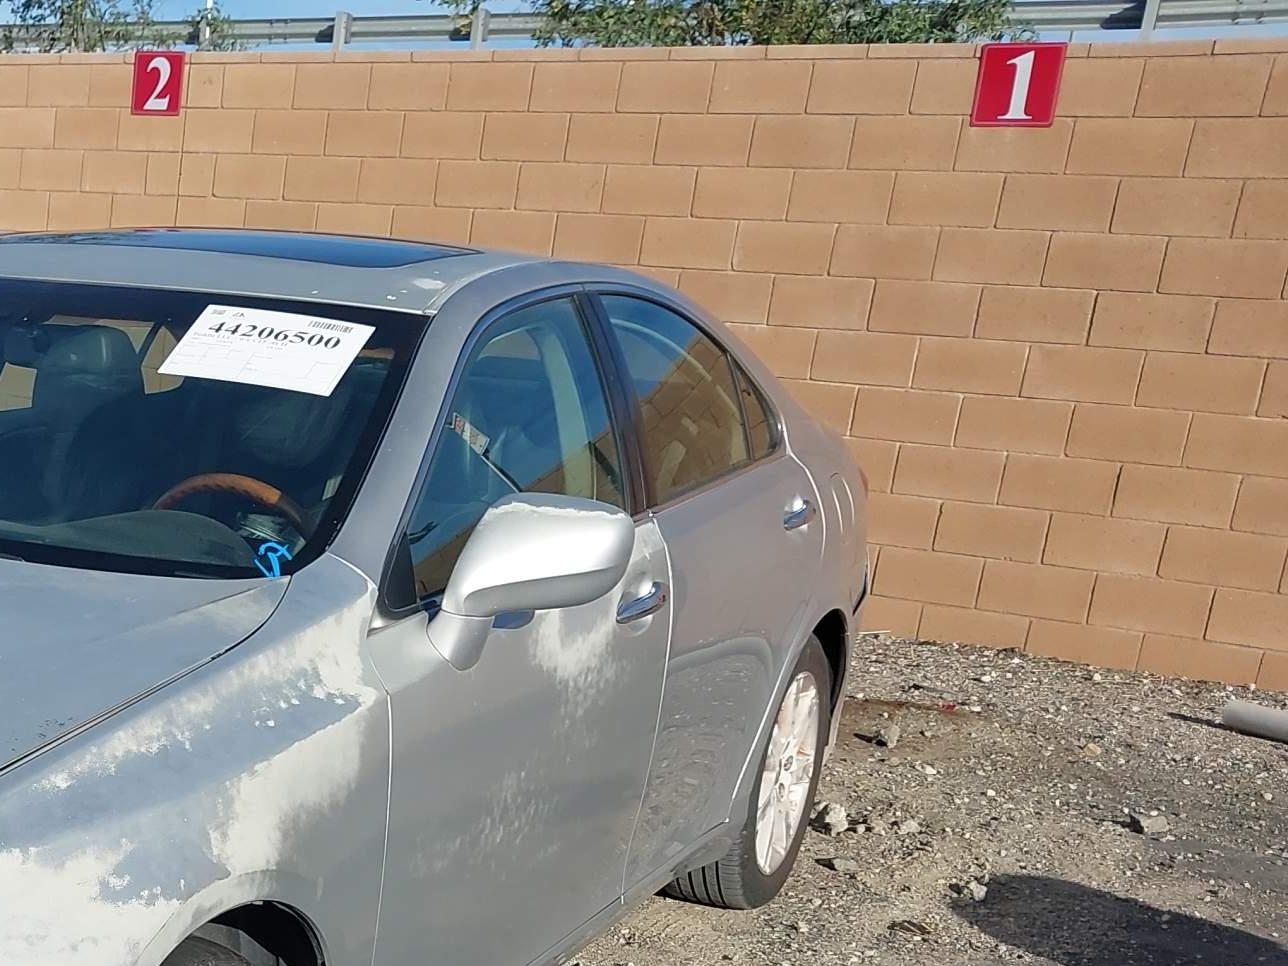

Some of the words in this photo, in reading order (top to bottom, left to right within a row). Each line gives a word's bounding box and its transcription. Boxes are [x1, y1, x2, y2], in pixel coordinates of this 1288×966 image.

[142, 56, 172, 111] 2
[996, 49, 1036, 120] 1
[208, 321, 342, 350] 44206500
